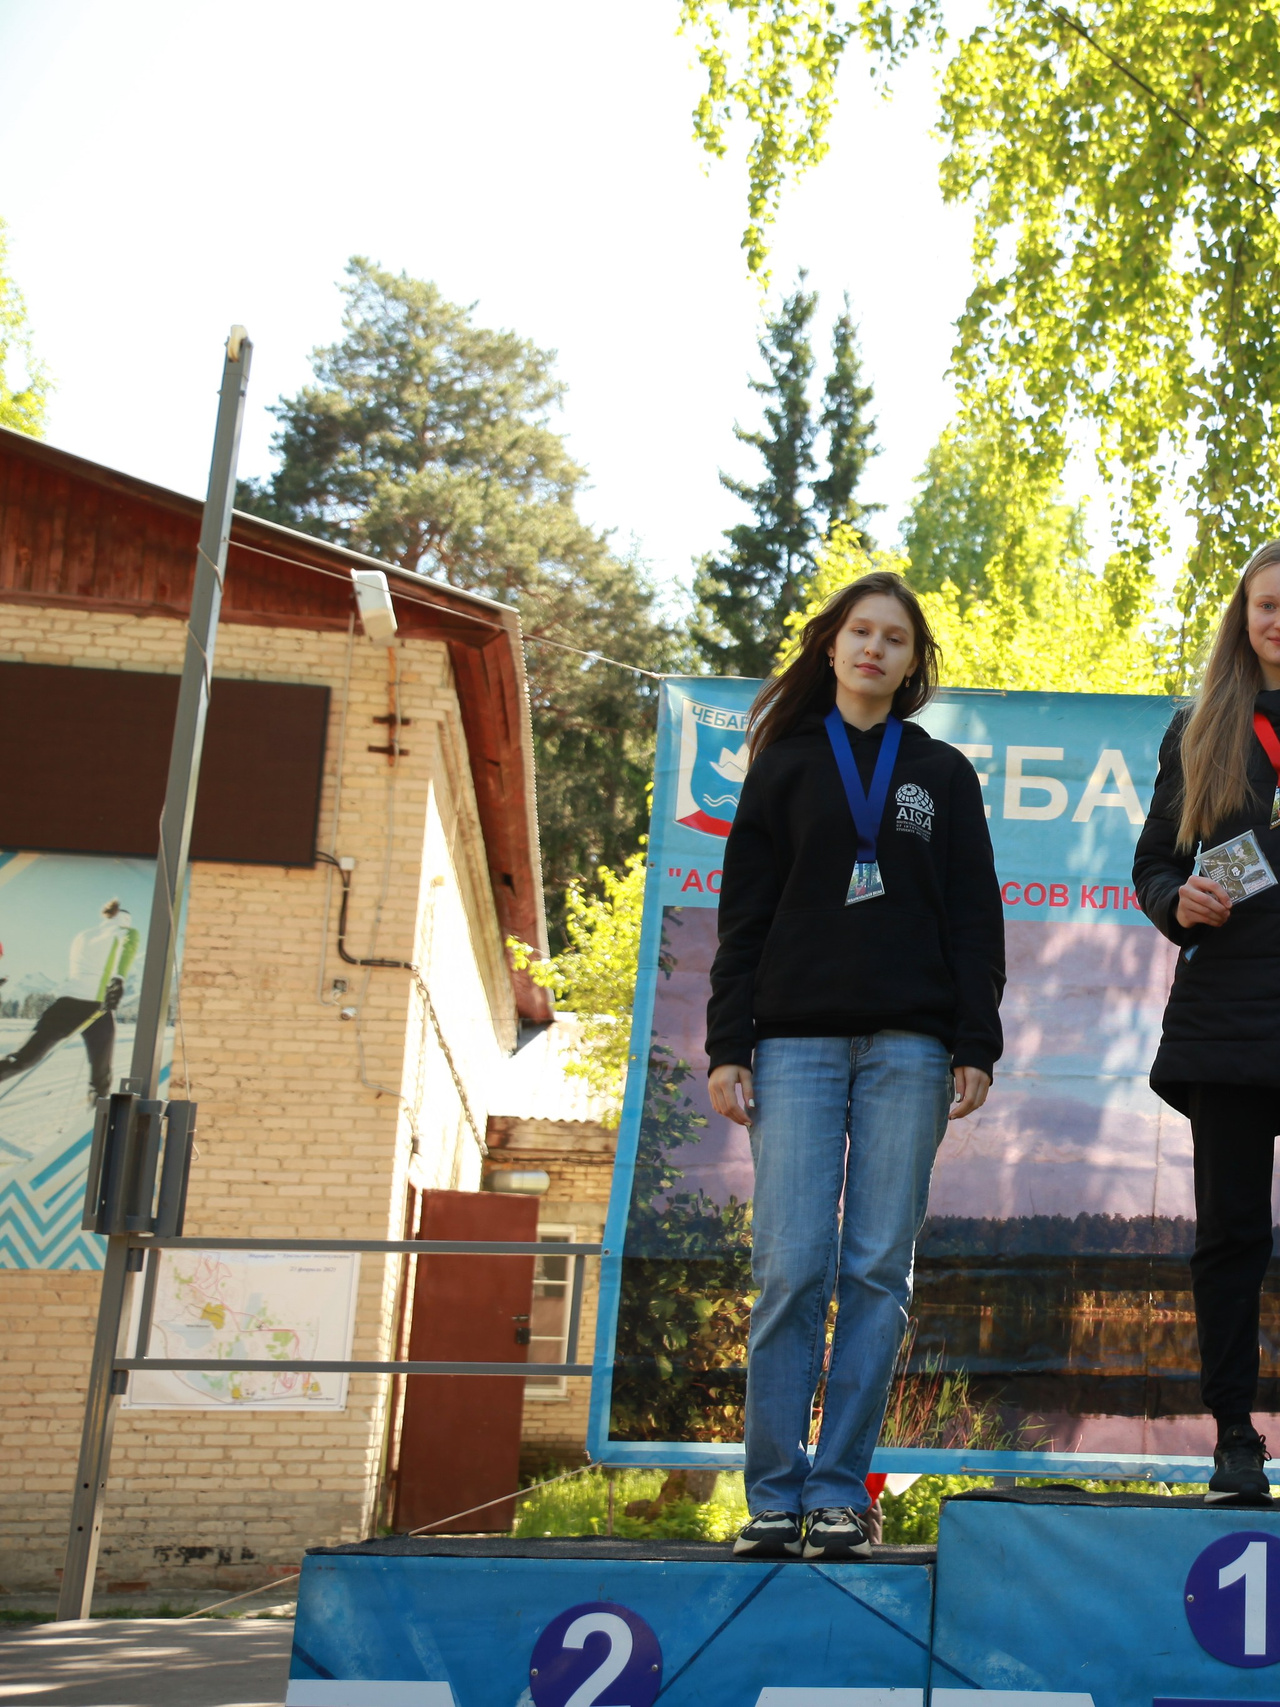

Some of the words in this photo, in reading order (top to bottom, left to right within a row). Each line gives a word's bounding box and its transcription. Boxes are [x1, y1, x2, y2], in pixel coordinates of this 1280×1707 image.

[896, 806, 932, 831] AISA
[1218, 1541, 1268, 1655] 1
[562, 1612, 634, 1707] 2
